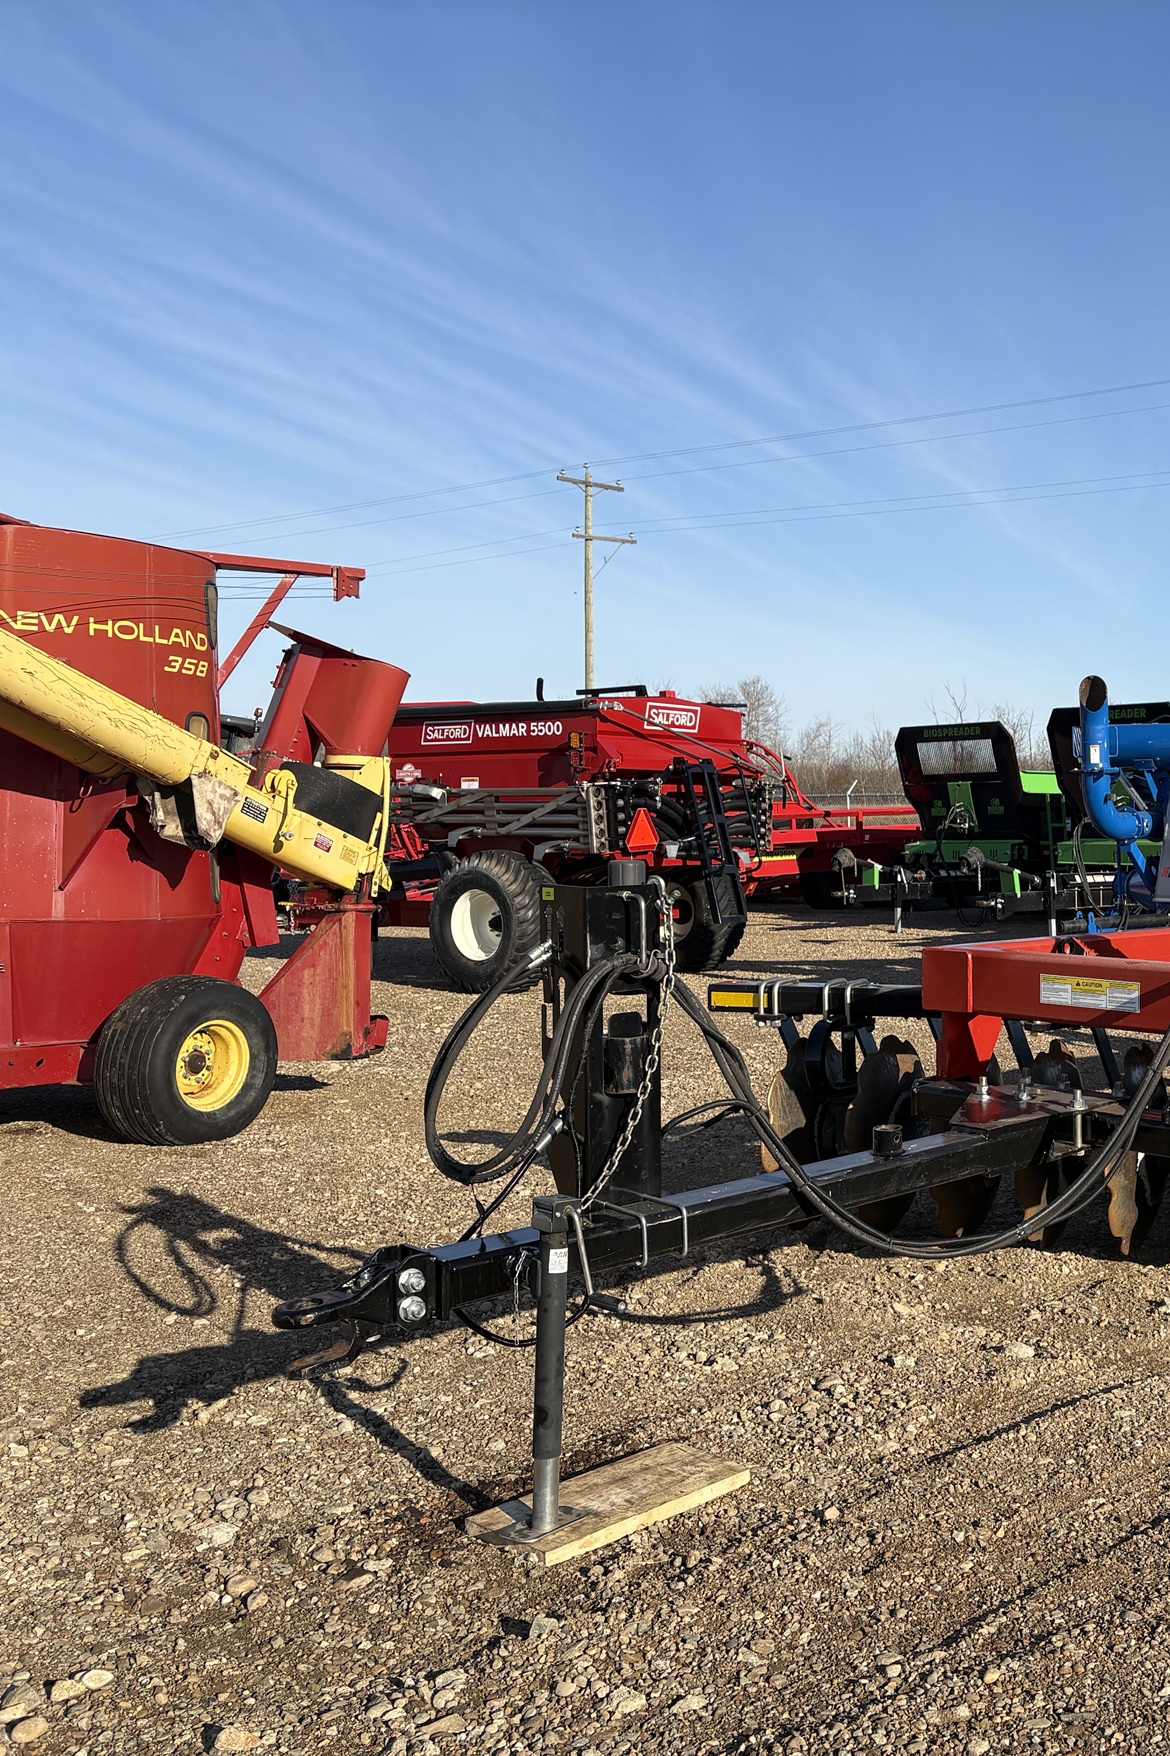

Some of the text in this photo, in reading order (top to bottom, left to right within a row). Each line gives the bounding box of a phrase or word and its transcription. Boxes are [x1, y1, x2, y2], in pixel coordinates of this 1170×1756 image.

[0, 609, 208, 652] NEW HOLLAND
[164, 655, 209, 678] 358
[649, 708, 696, 727] SALFORD
[425, 721, 562, 740] SALFORD VALMAR 5500
[923, 726, 981, 738] BIOSPREADER
